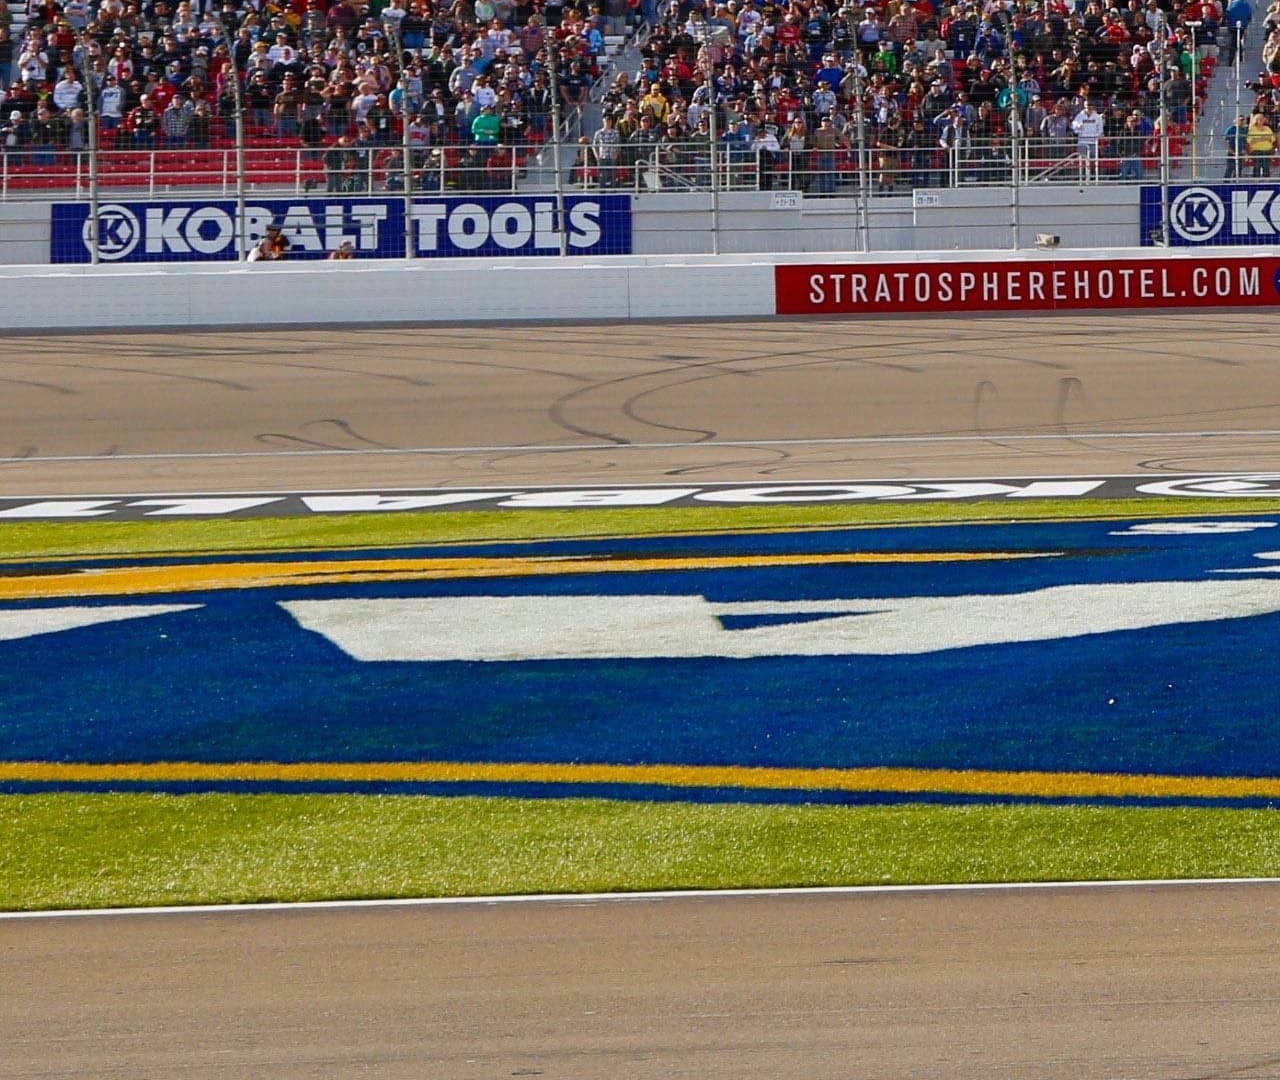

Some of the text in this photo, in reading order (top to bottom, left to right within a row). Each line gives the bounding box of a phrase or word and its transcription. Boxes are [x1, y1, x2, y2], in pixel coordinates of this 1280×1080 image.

[145, 205, 387, 254] KOBALT
[412, 202, 601, 249] TOOLS
[809, 266, 1260, 304] STRATOSPHEREHOTEL.COM
